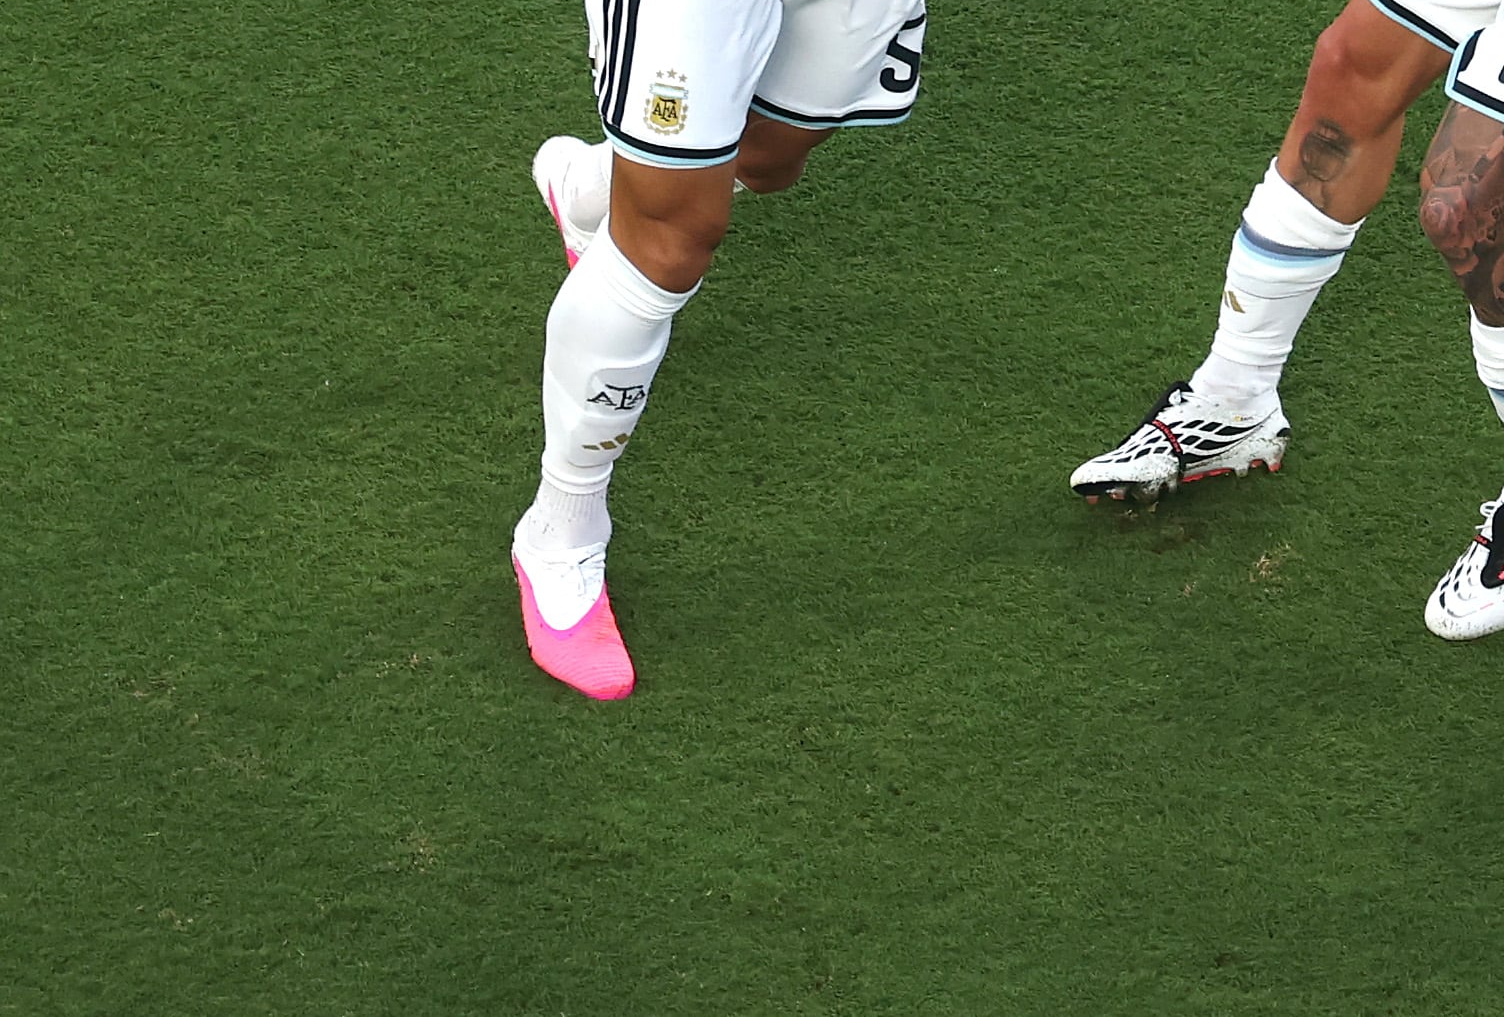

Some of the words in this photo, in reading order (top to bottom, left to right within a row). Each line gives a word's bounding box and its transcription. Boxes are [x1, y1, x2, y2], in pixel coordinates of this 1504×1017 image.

[879, 13, 926, 93] 5
[652, 96, 678, 122] AFA
[587, 383, 646, 411] AFA
